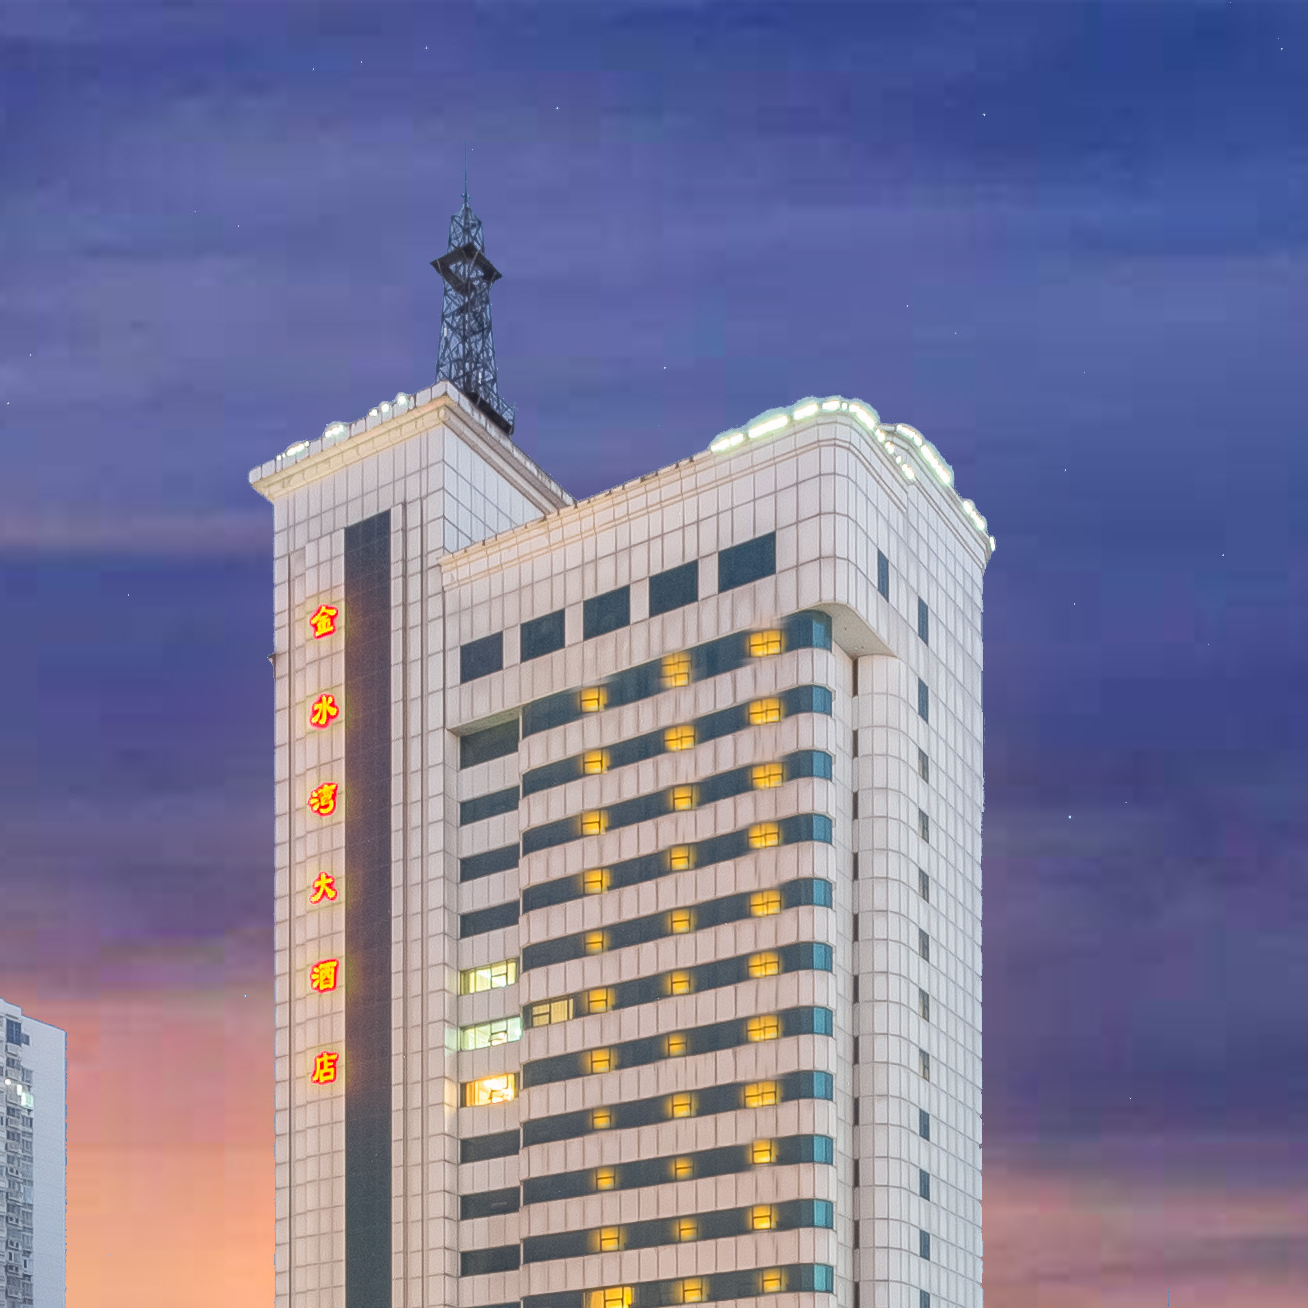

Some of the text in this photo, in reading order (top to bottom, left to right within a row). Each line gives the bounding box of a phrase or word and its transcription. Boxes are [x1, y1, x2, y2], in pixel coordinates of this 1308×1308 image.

[308, 605, 339, 1086] 金水湾大酒店
